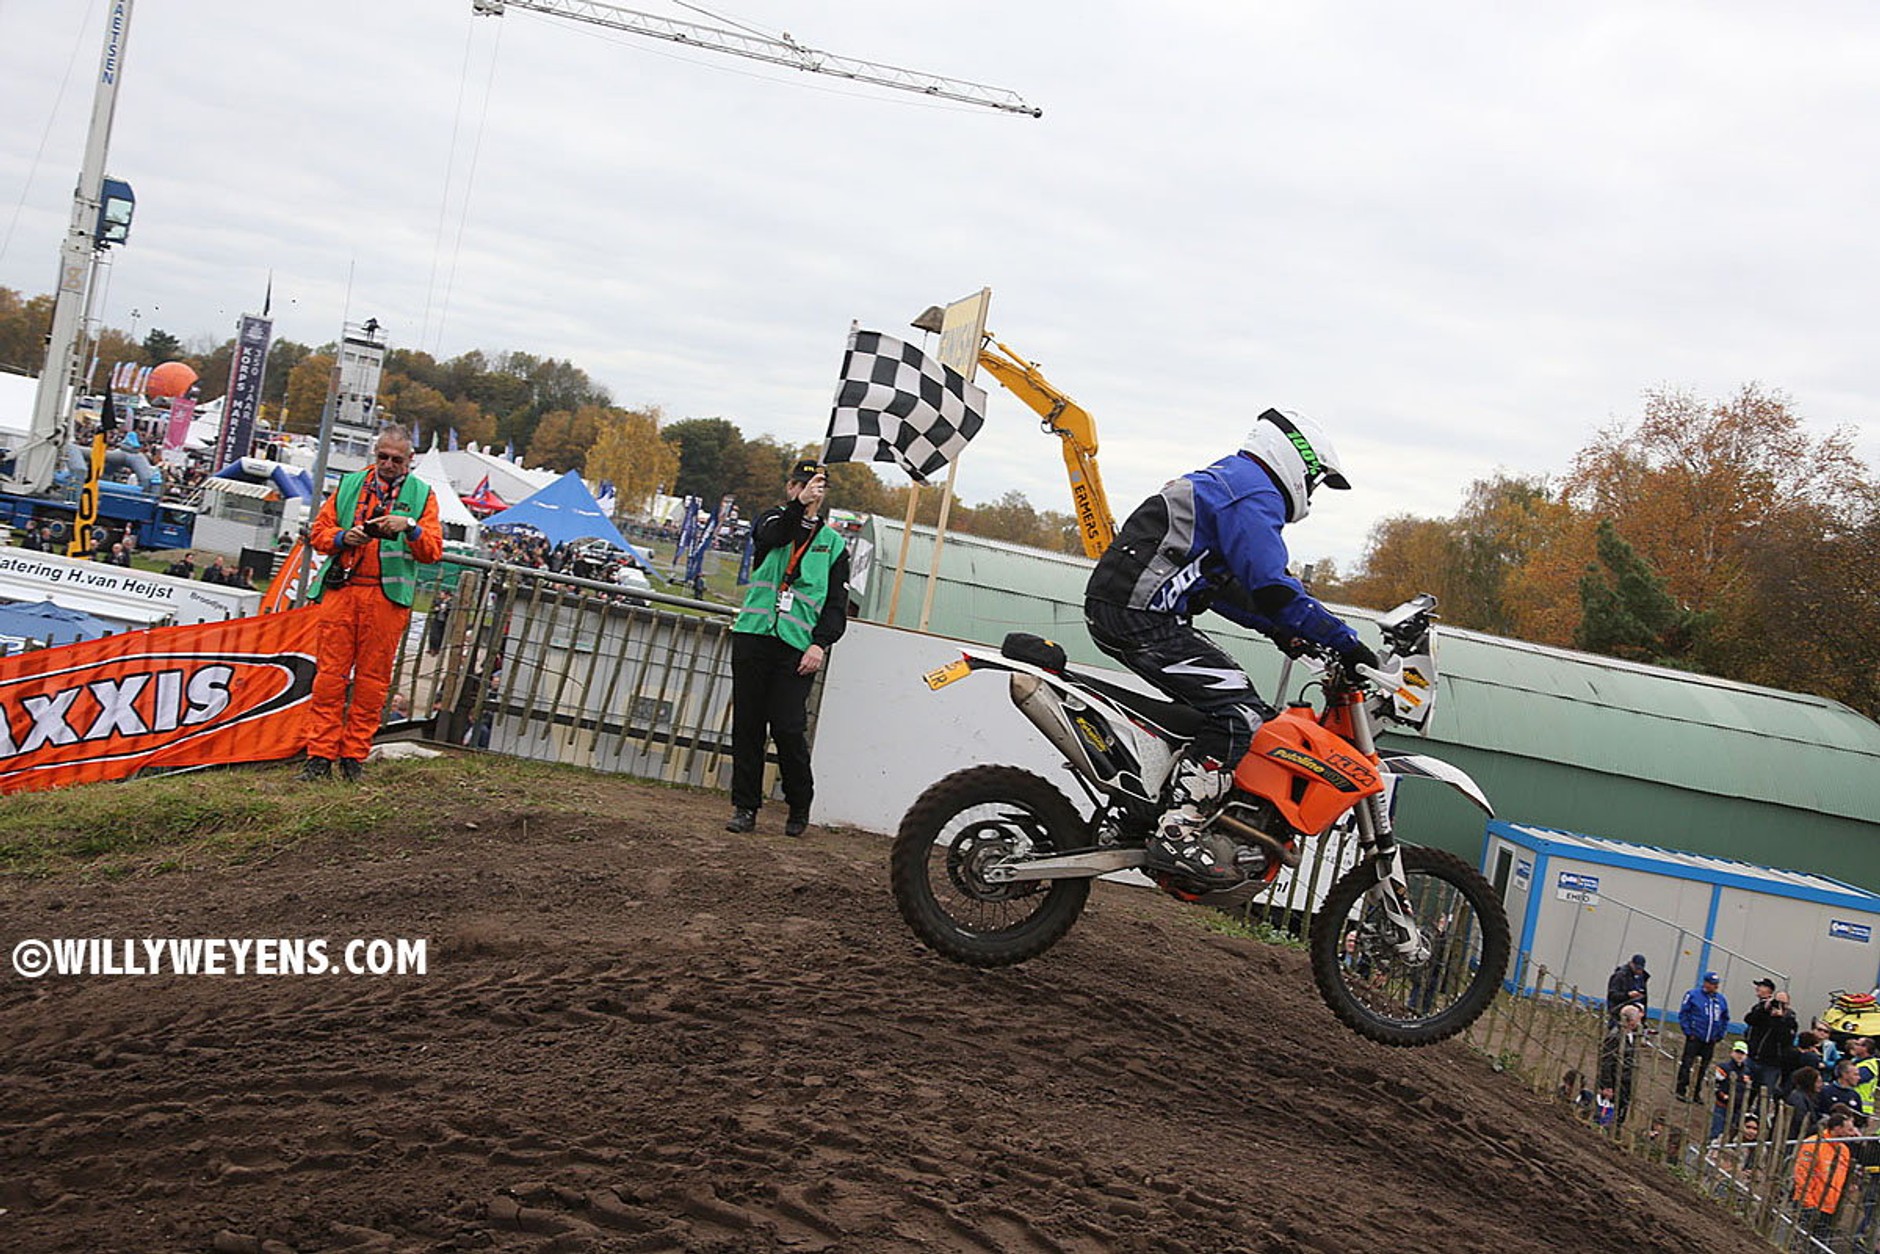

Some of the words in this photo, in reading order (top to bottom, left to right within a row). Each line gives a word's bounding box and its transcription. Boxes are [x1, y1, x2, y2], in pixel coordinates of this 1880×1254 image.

[102, 0, 126, 84] AETSEN
[236, 347, 253, 392] KORPS
[1286, 431, 1320, 476] 100%
[1074, 484, 1099, 539] ERMERS
[0, 556, 64, 582] atering
[67, 568, 118, 590] H.van
[122, 578, 174, 599] Heijst
[1149, 549, 1209, 612] JOPA
[1326, 753, 1377, 788] KTM
